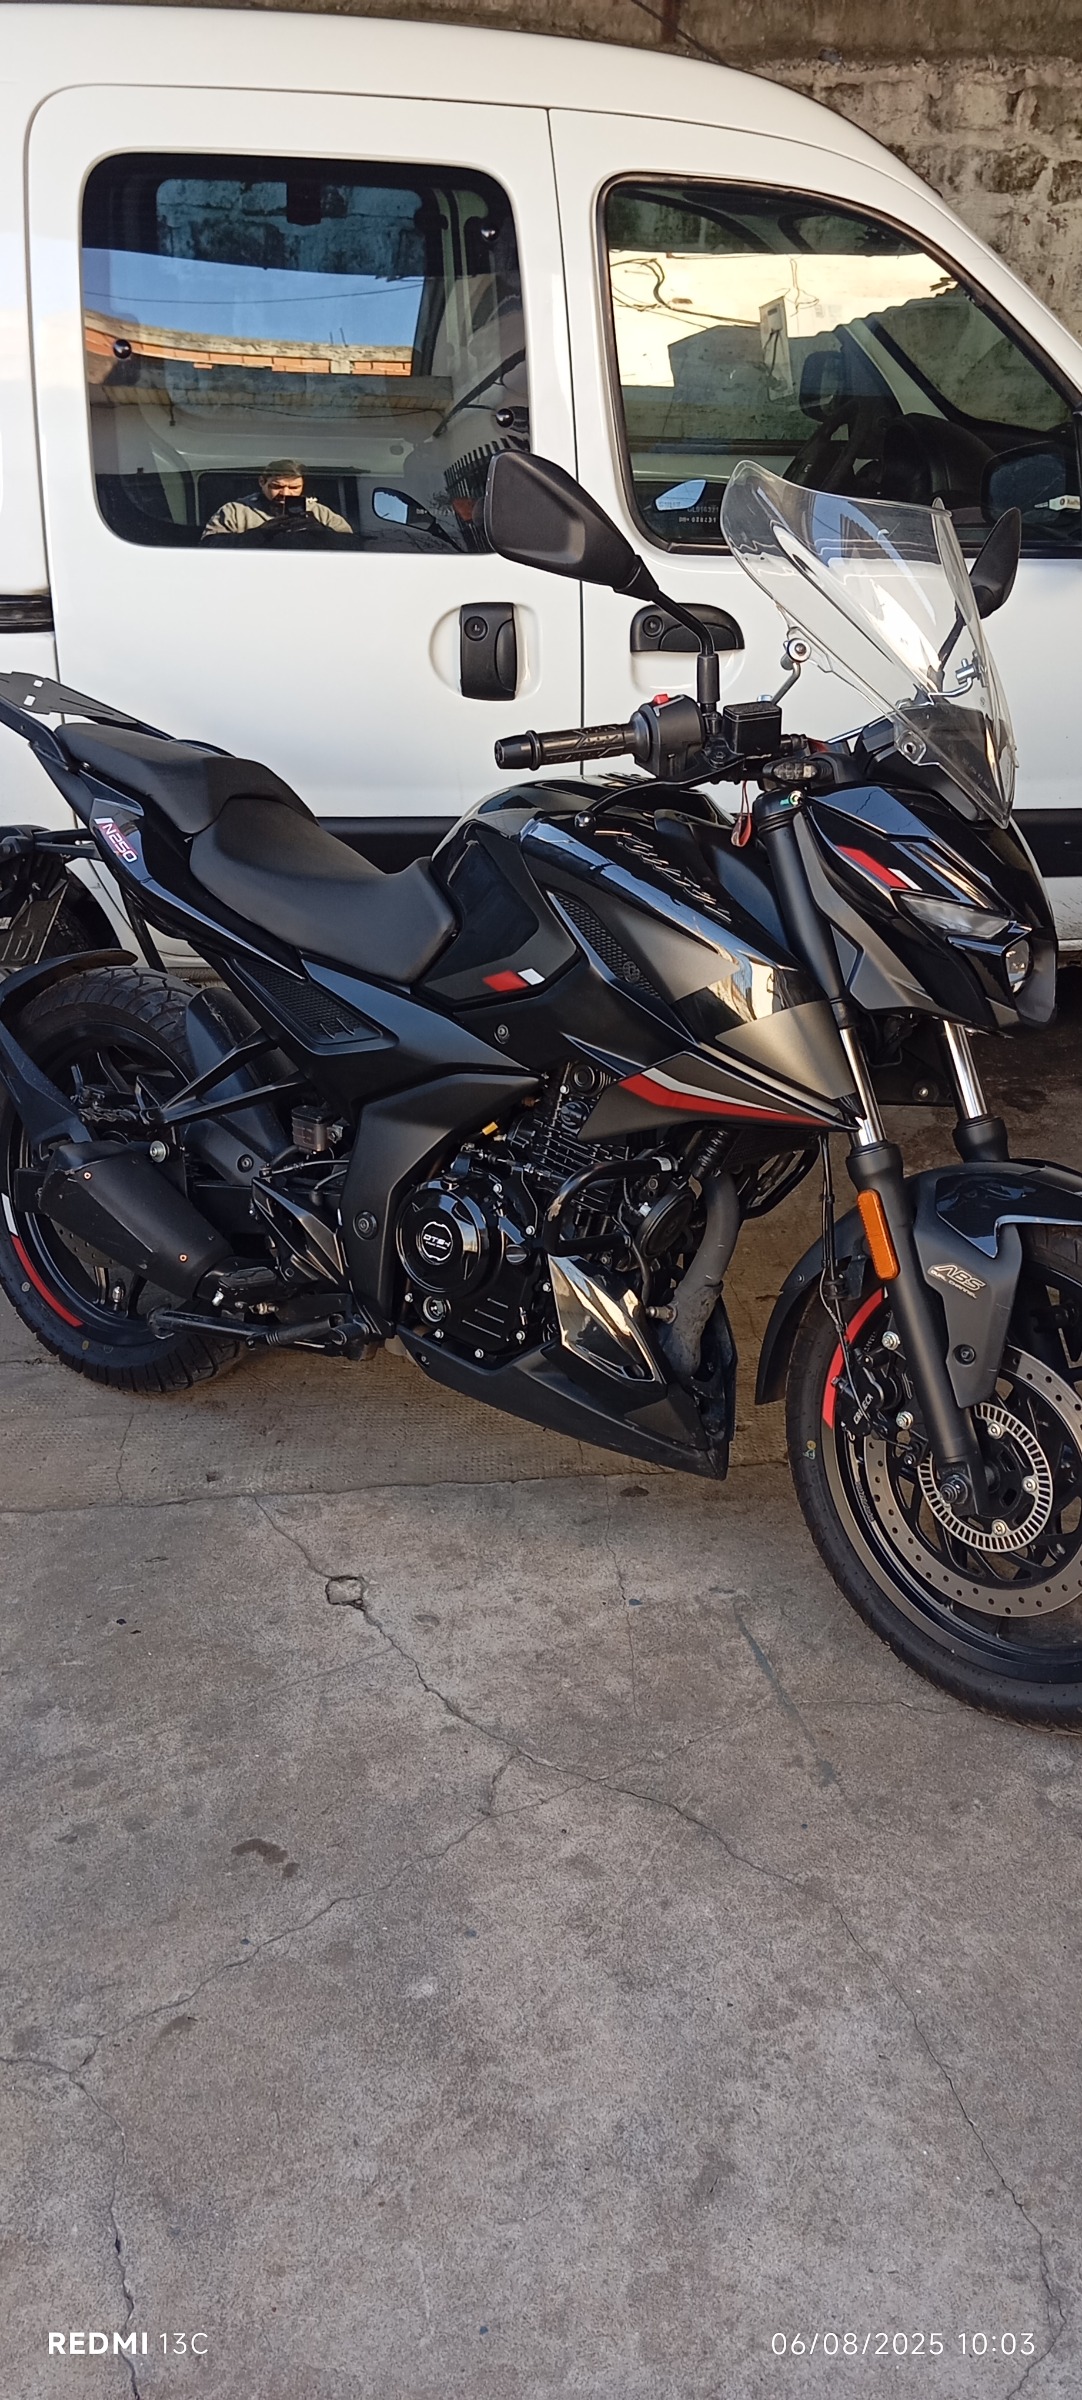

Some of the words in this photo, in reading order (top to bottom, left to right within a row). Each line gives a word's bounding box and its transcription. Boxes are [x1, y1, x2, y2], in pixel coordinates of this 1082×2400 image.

[102, 823, 137, 862] N250
[933, 1264, 986, 1291] ABS
[853, 1392, 874, 1425] GRIECA
